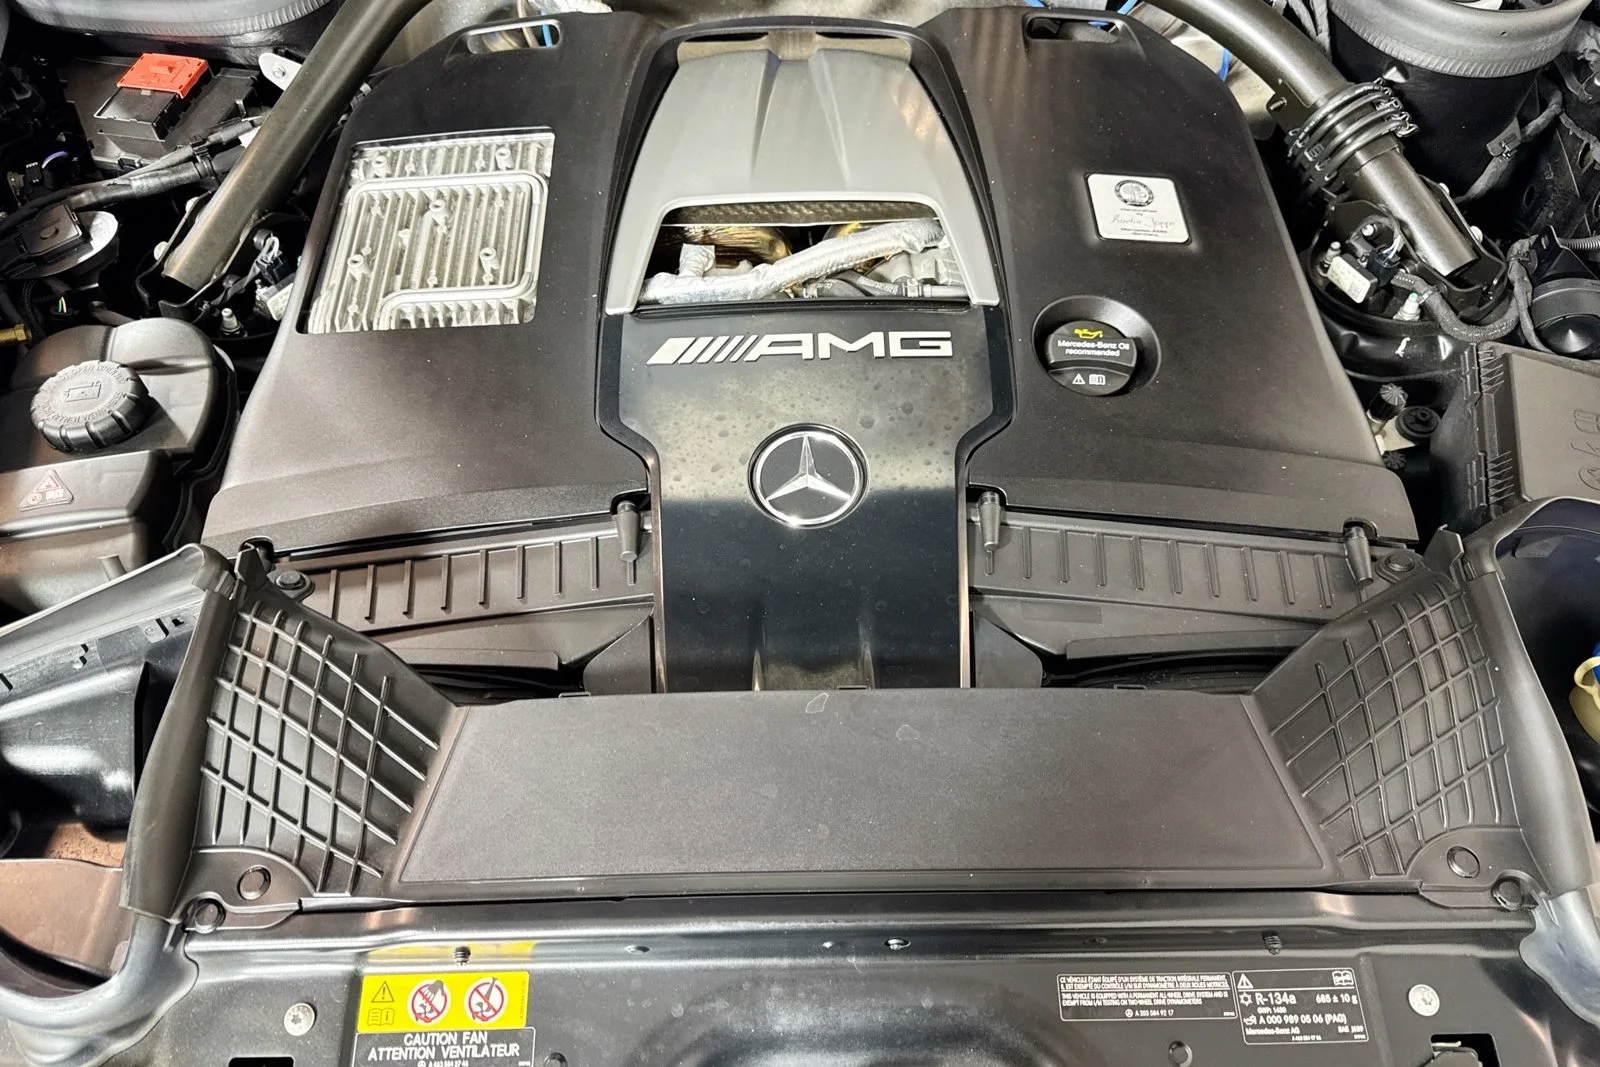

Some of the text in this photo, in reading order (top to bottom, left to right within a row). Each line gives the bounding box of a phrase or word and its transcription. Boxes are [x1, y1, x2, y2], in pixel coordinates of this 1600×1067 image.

[744, 331, 953, 362] AMG
[1058, 340, 1130, 350] Mercedes-Benz Oil
[1065, 348, 1120, 357] recommended
[1255, 992, 1297, 1006] R-134a
[1316, 994, 1332, 1004] 685
[1340, 993, 1350, 1003] 10
[1259, 1013, 1347, 1025] A 000 989 05 06 (PAG)
[1245, 1026, 1300, 1035] Mercedes-Benz AG
[404, 1031, 488, 1046] CAUTION FAN
[368, 1044, 520, 1061] ATTENTION VENTILATEUR
